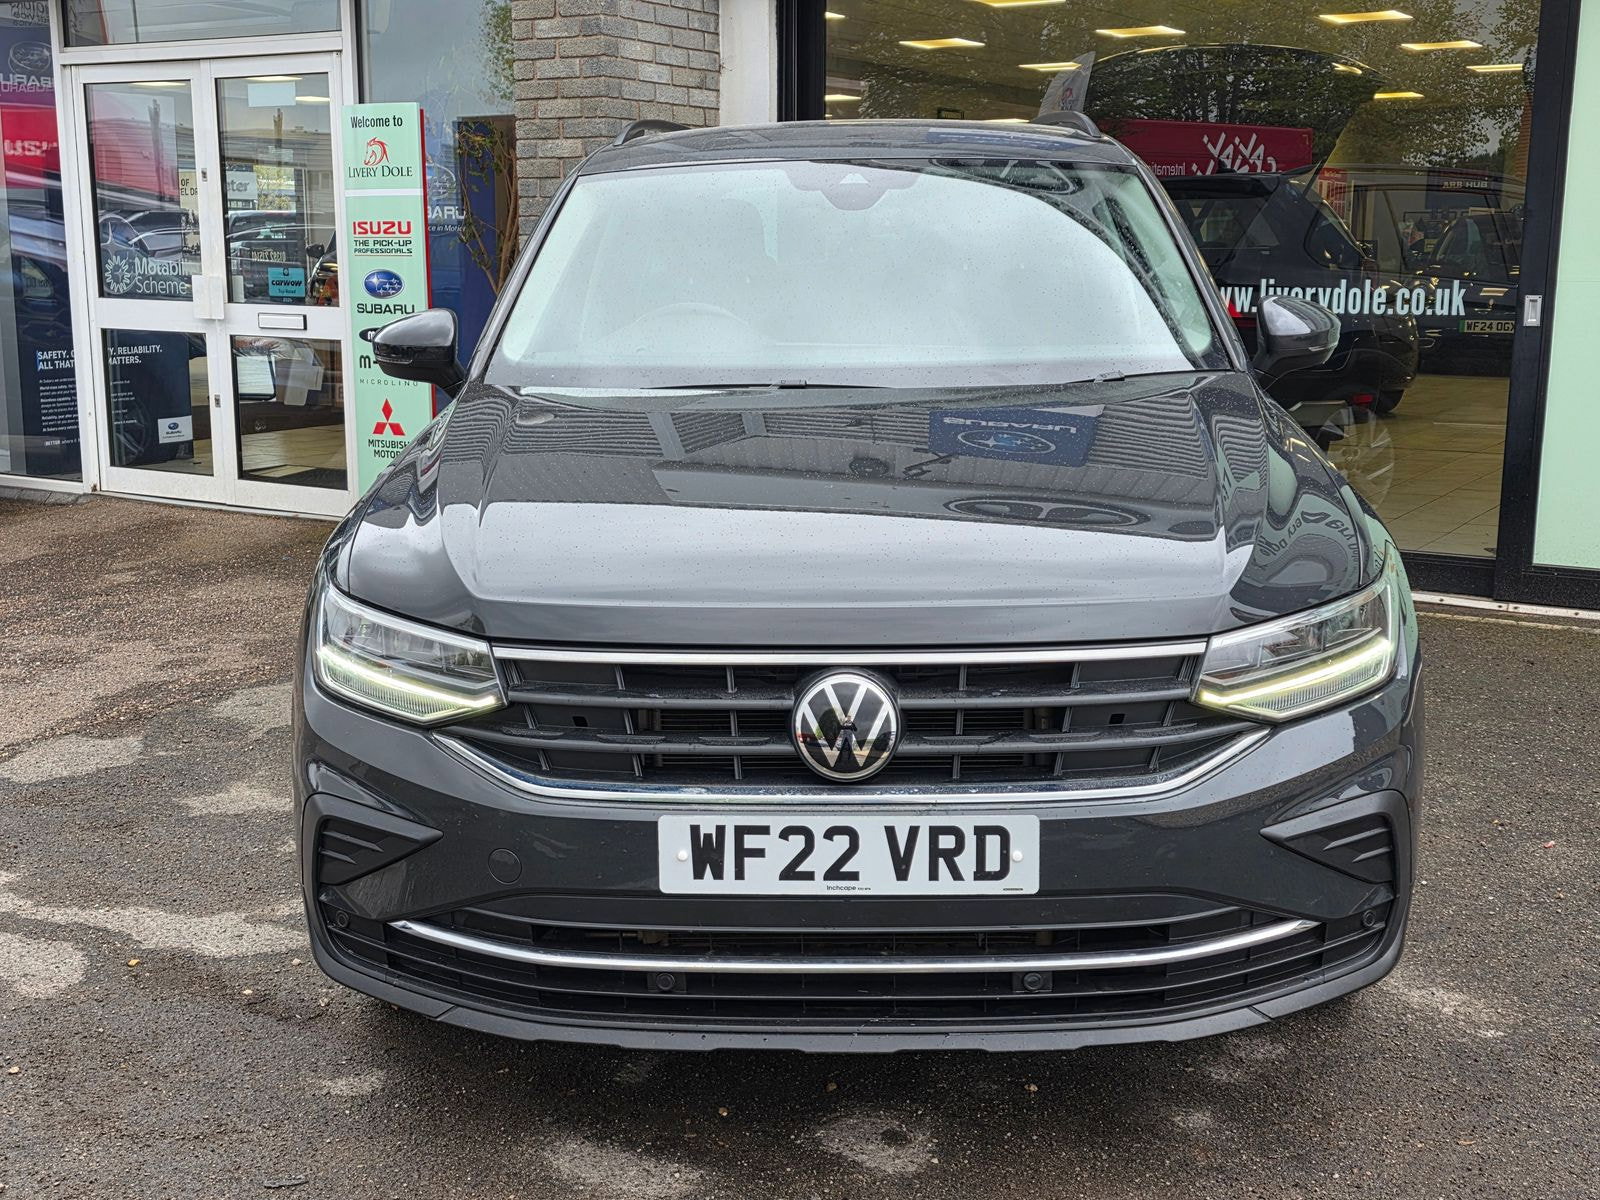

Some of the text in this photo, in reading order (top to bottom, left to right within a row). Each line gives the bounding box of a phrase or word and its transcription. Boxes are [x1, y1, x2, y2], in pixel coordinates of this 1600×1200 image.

[350, 115, 403, 129] Welcome to
[348, 165, 413, 178] LIVERY DOLE
[181, 179, 190, 187] OF
[353, 221, 412, 235] ISUZU
[354, 239, 412, 247] THE PICK-UP
[136, 277, 188, 295] Scheme
[271, 279, 303, 287] carwow
[356, 304, 415, 315] SUBARU
[1466, 321, 1494, 332] WF24
[38, 350, 69, 360] SAFETY.
[117, 345, 163, 355] RELIABILITY.
[39, 361, 54, 370] ALL
[54, 360, 75, 369] THAT
[689, 824, 1011, 882] WF22 VRD
